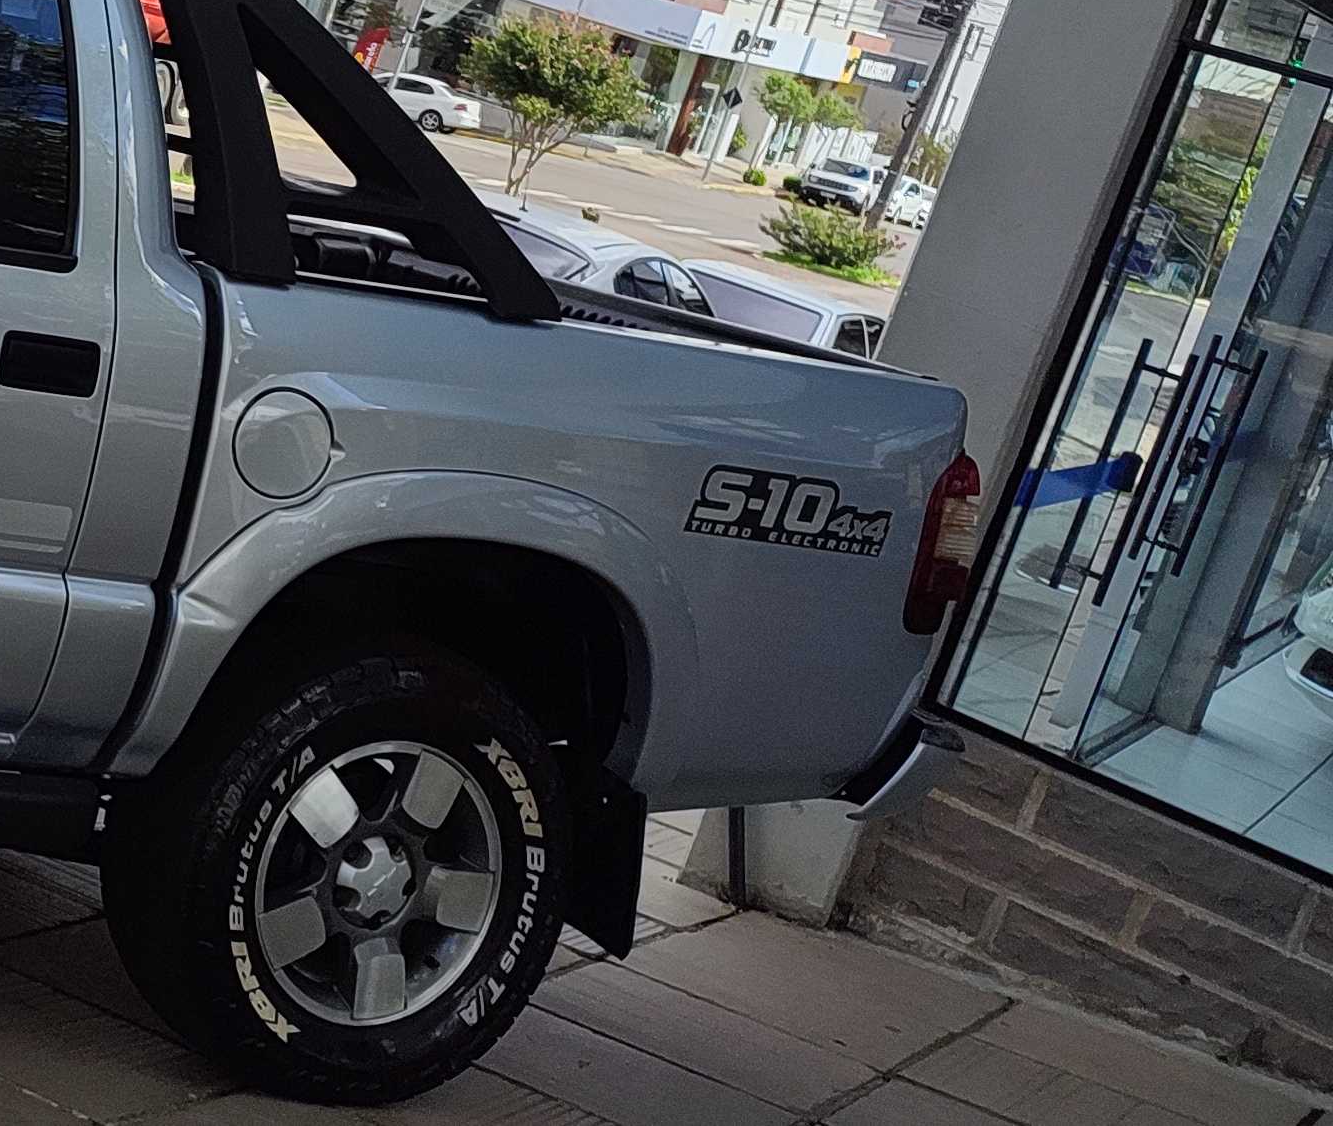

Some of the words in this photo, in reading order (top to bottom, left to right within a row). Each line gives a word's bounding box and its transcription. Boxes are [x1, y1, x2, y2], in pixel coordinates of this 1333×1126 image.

[690, 520, 752, 539] TURBO
[768, 531, 882, 557] ELECTRONIC
[693, 471, 835, 535] S-10
[827, 512, 889, 542] 4x4
[272, 746, 316, 796] T/A
[473, 738, 544, 838] XBRI
[228, 799, 272, 931] Brutus
[499, 845, 546, 974] Brutus
[230, 941, 301, 1044] XBRI
[459, 980, 506, 1028] T/A
